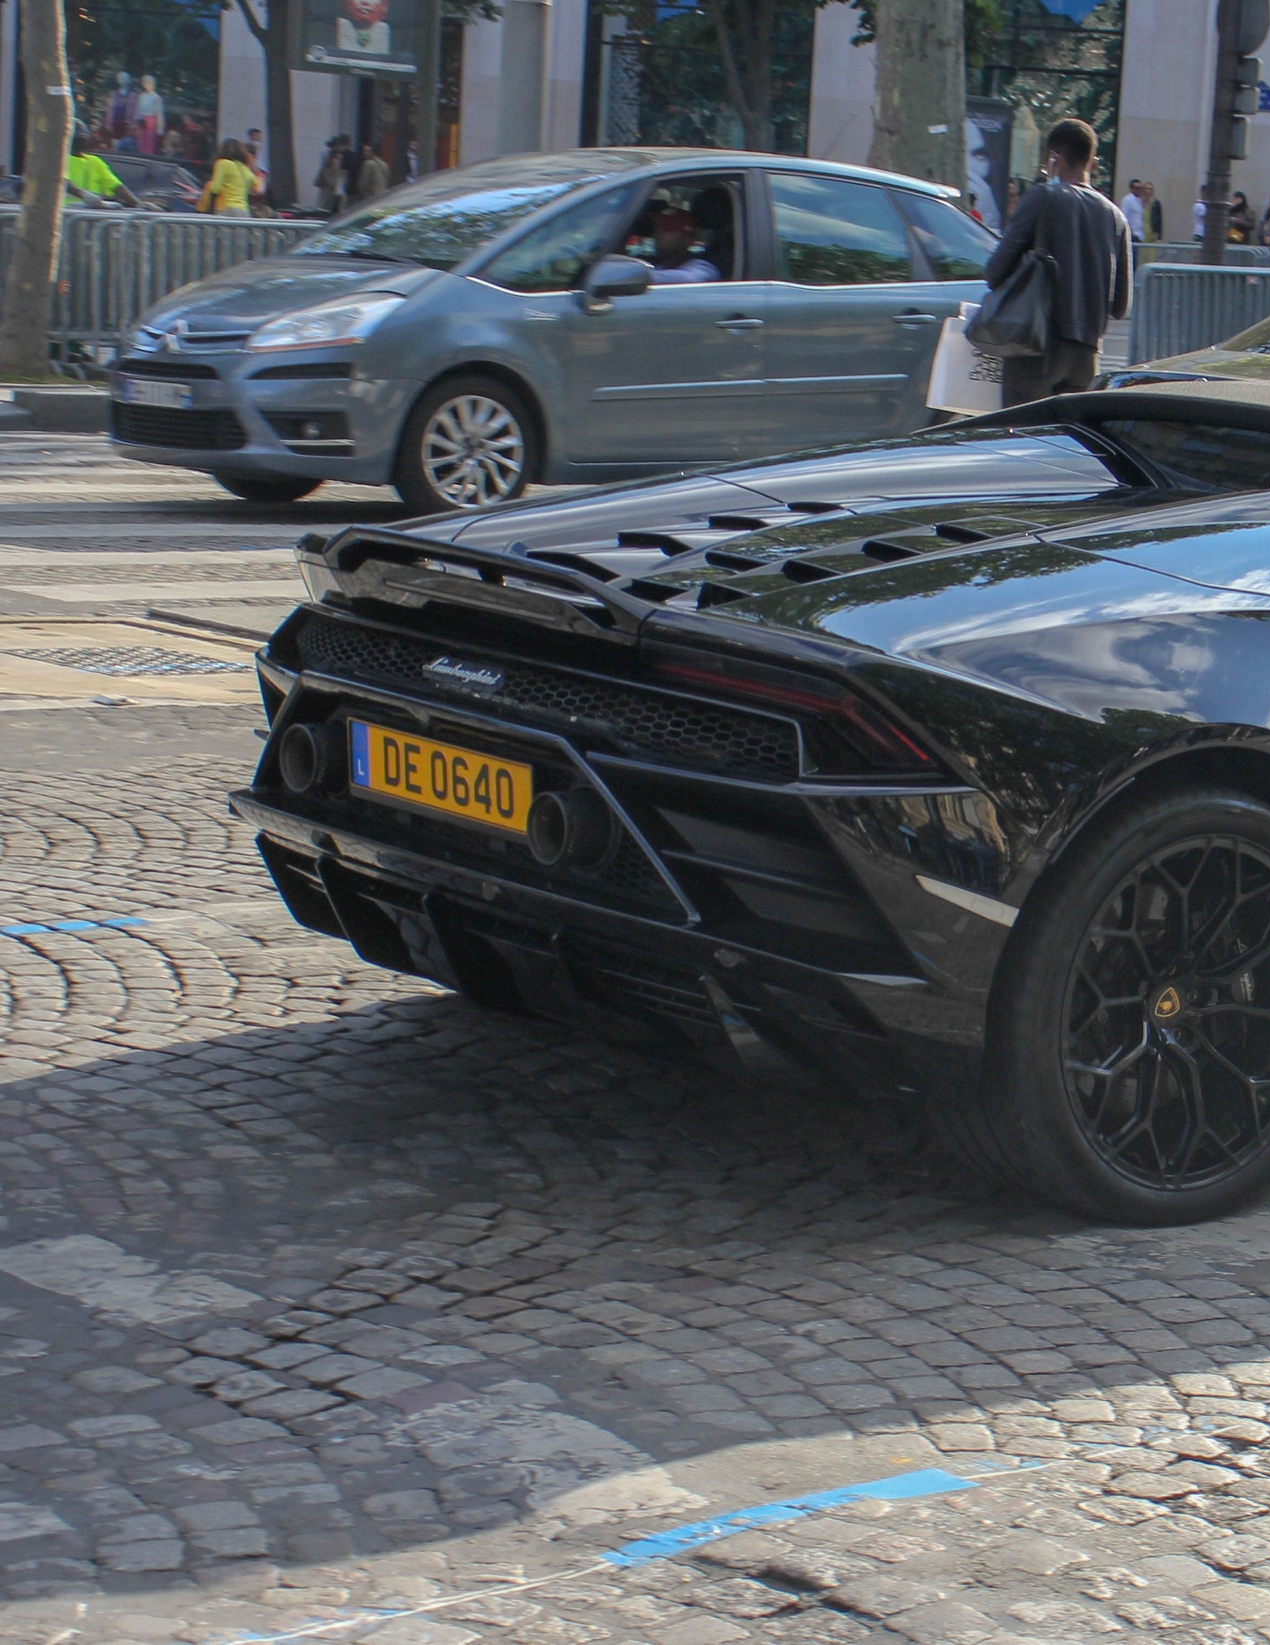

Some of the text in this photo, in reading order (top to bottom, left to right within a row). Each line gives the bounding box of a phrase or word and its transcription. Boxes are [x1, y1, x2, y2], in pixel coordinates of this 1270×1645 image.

[422, 657, 501, 685] Lamborghini
[357, 758, 365, 777] L
[383, 736, 514, 819] DE 0640
